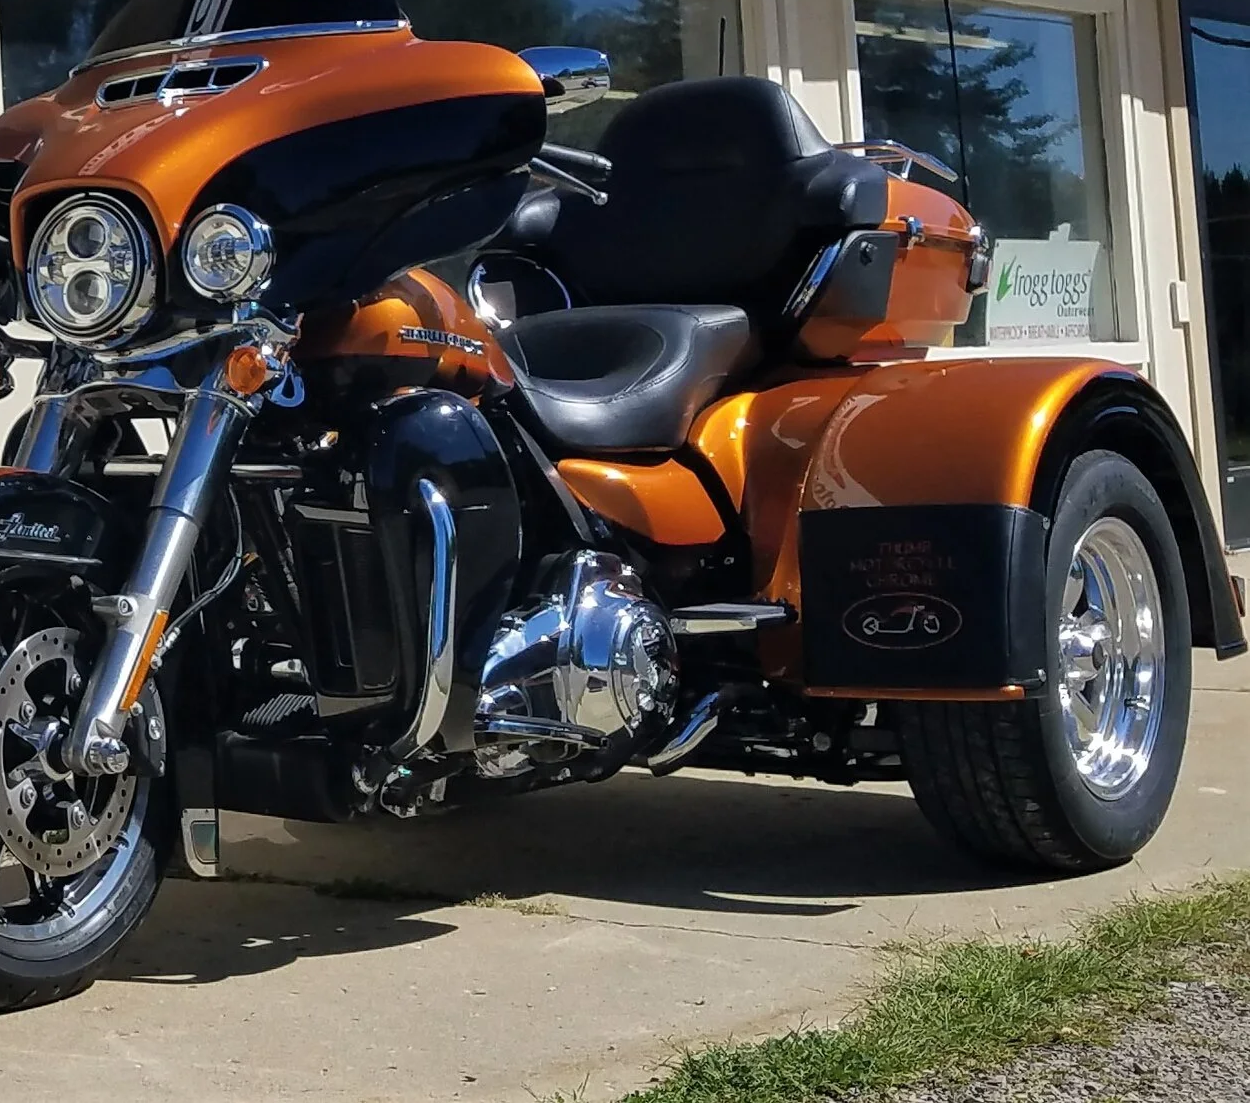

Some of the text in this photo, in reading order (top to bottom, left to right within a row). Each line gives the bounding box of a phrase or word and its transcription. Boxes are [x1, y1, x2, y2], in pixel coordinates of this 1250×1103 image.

[1013, 265, 1090, 307] frogg toggs
[849, 555, 957, 573] MOTRCYLE
